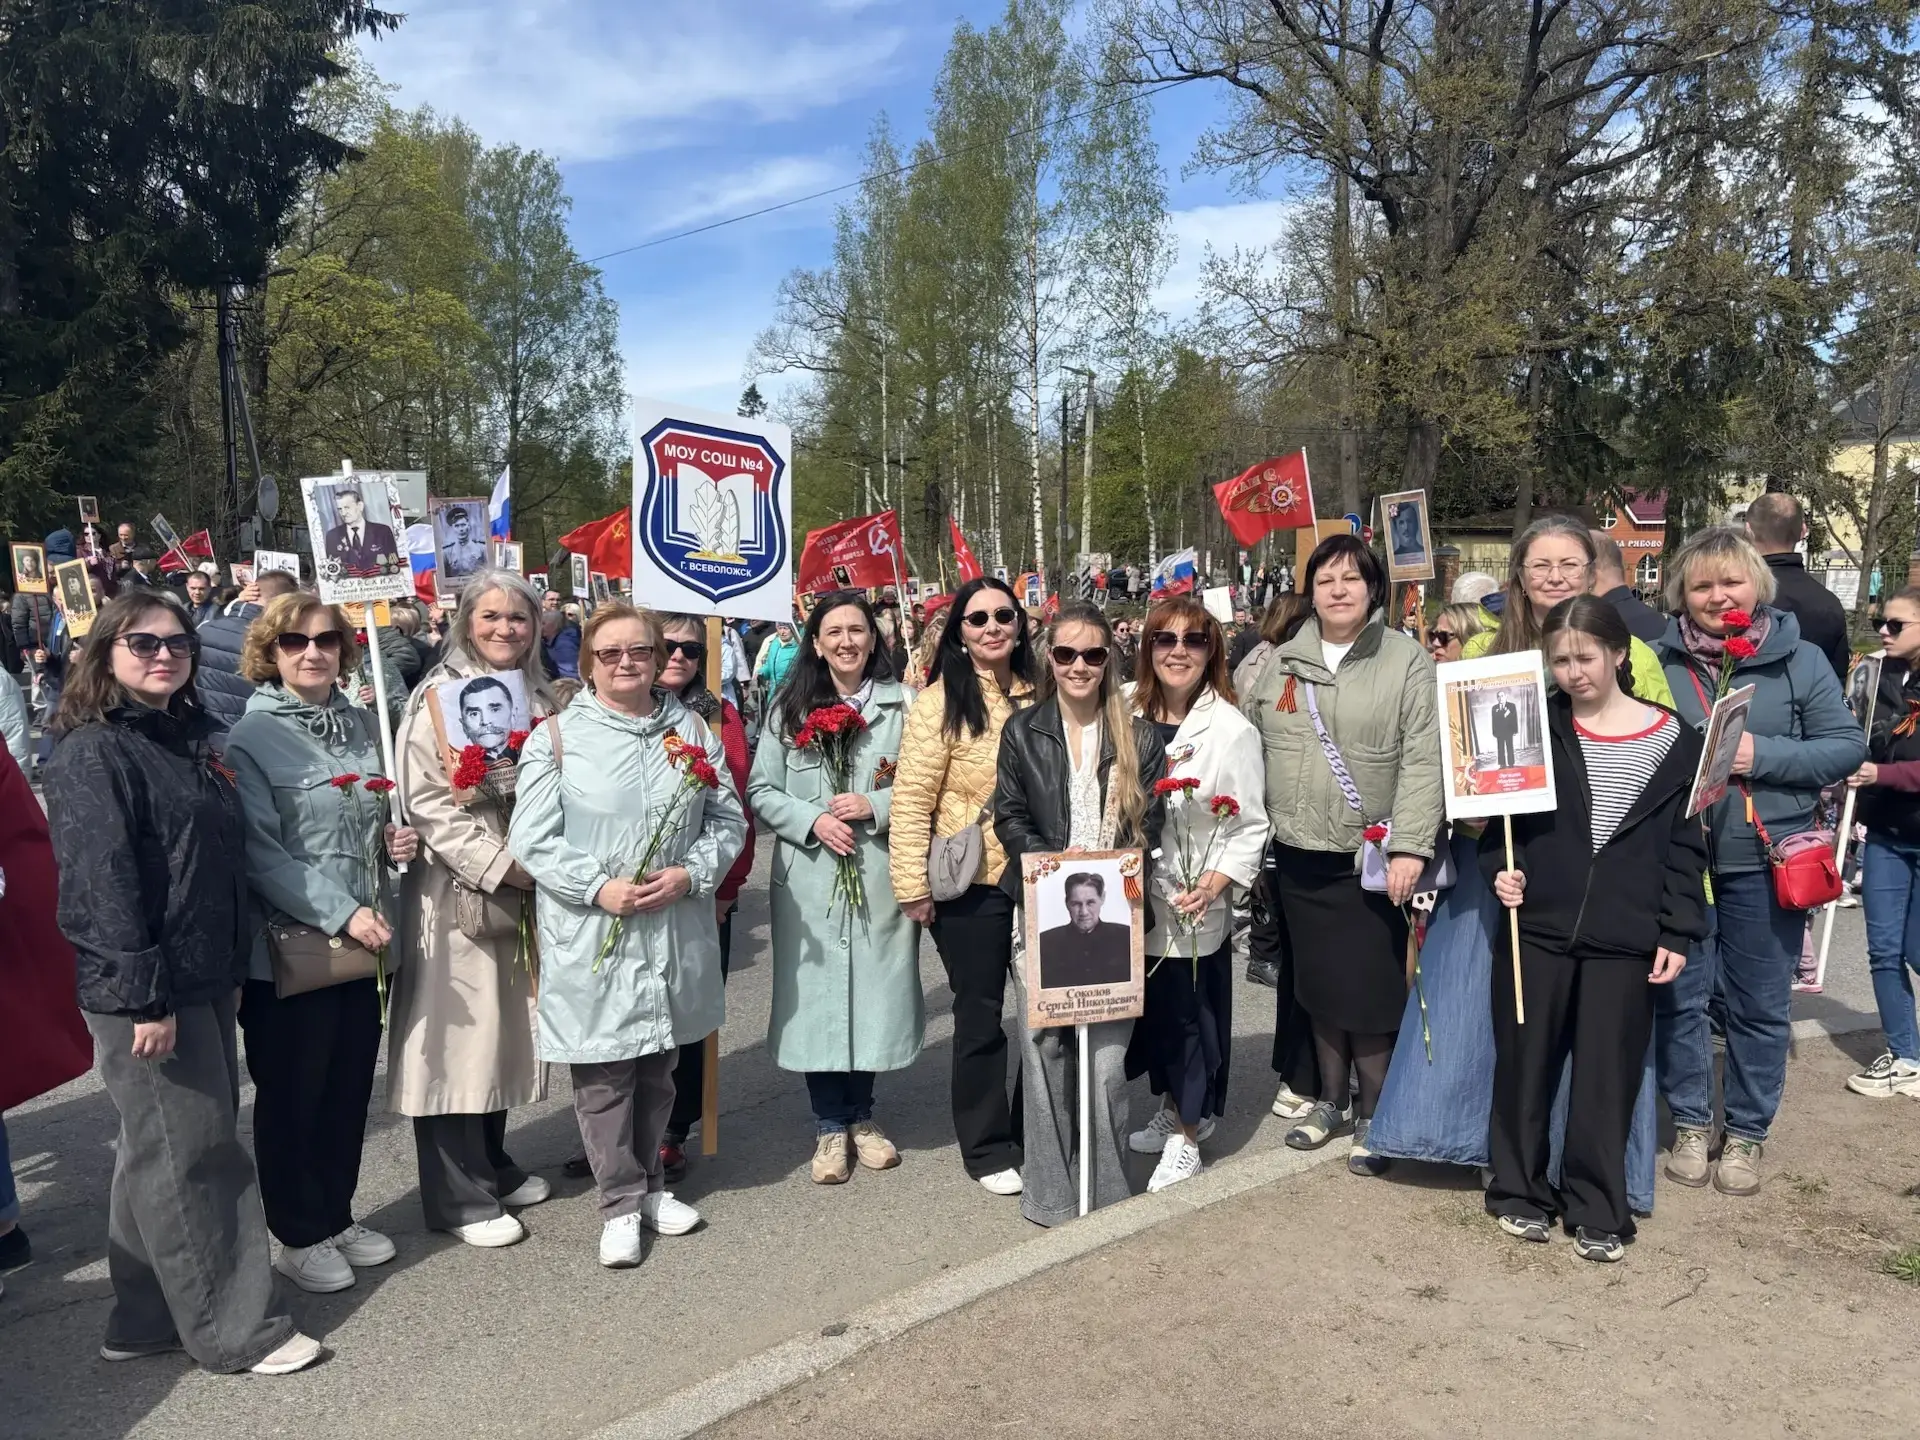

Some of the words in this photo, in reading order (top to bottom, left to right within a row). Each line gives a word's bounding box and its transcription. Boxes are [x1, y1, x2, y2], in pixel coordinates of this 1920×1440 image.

[664, 443, 697, 460] МОУ
[700, 450, 736, 468] СОШ
[740, 456, 764, 472] №4
[689, 562, 752, 577] ВСЕВОЛОЖСК
[1066, 988, 1111, 999] Соколов
[1037, 998, 1074, 1012] Сергей
[1077, 995, 1138, 1009] Николаевич
[1106, 1004, 1129, 1016] фронт
